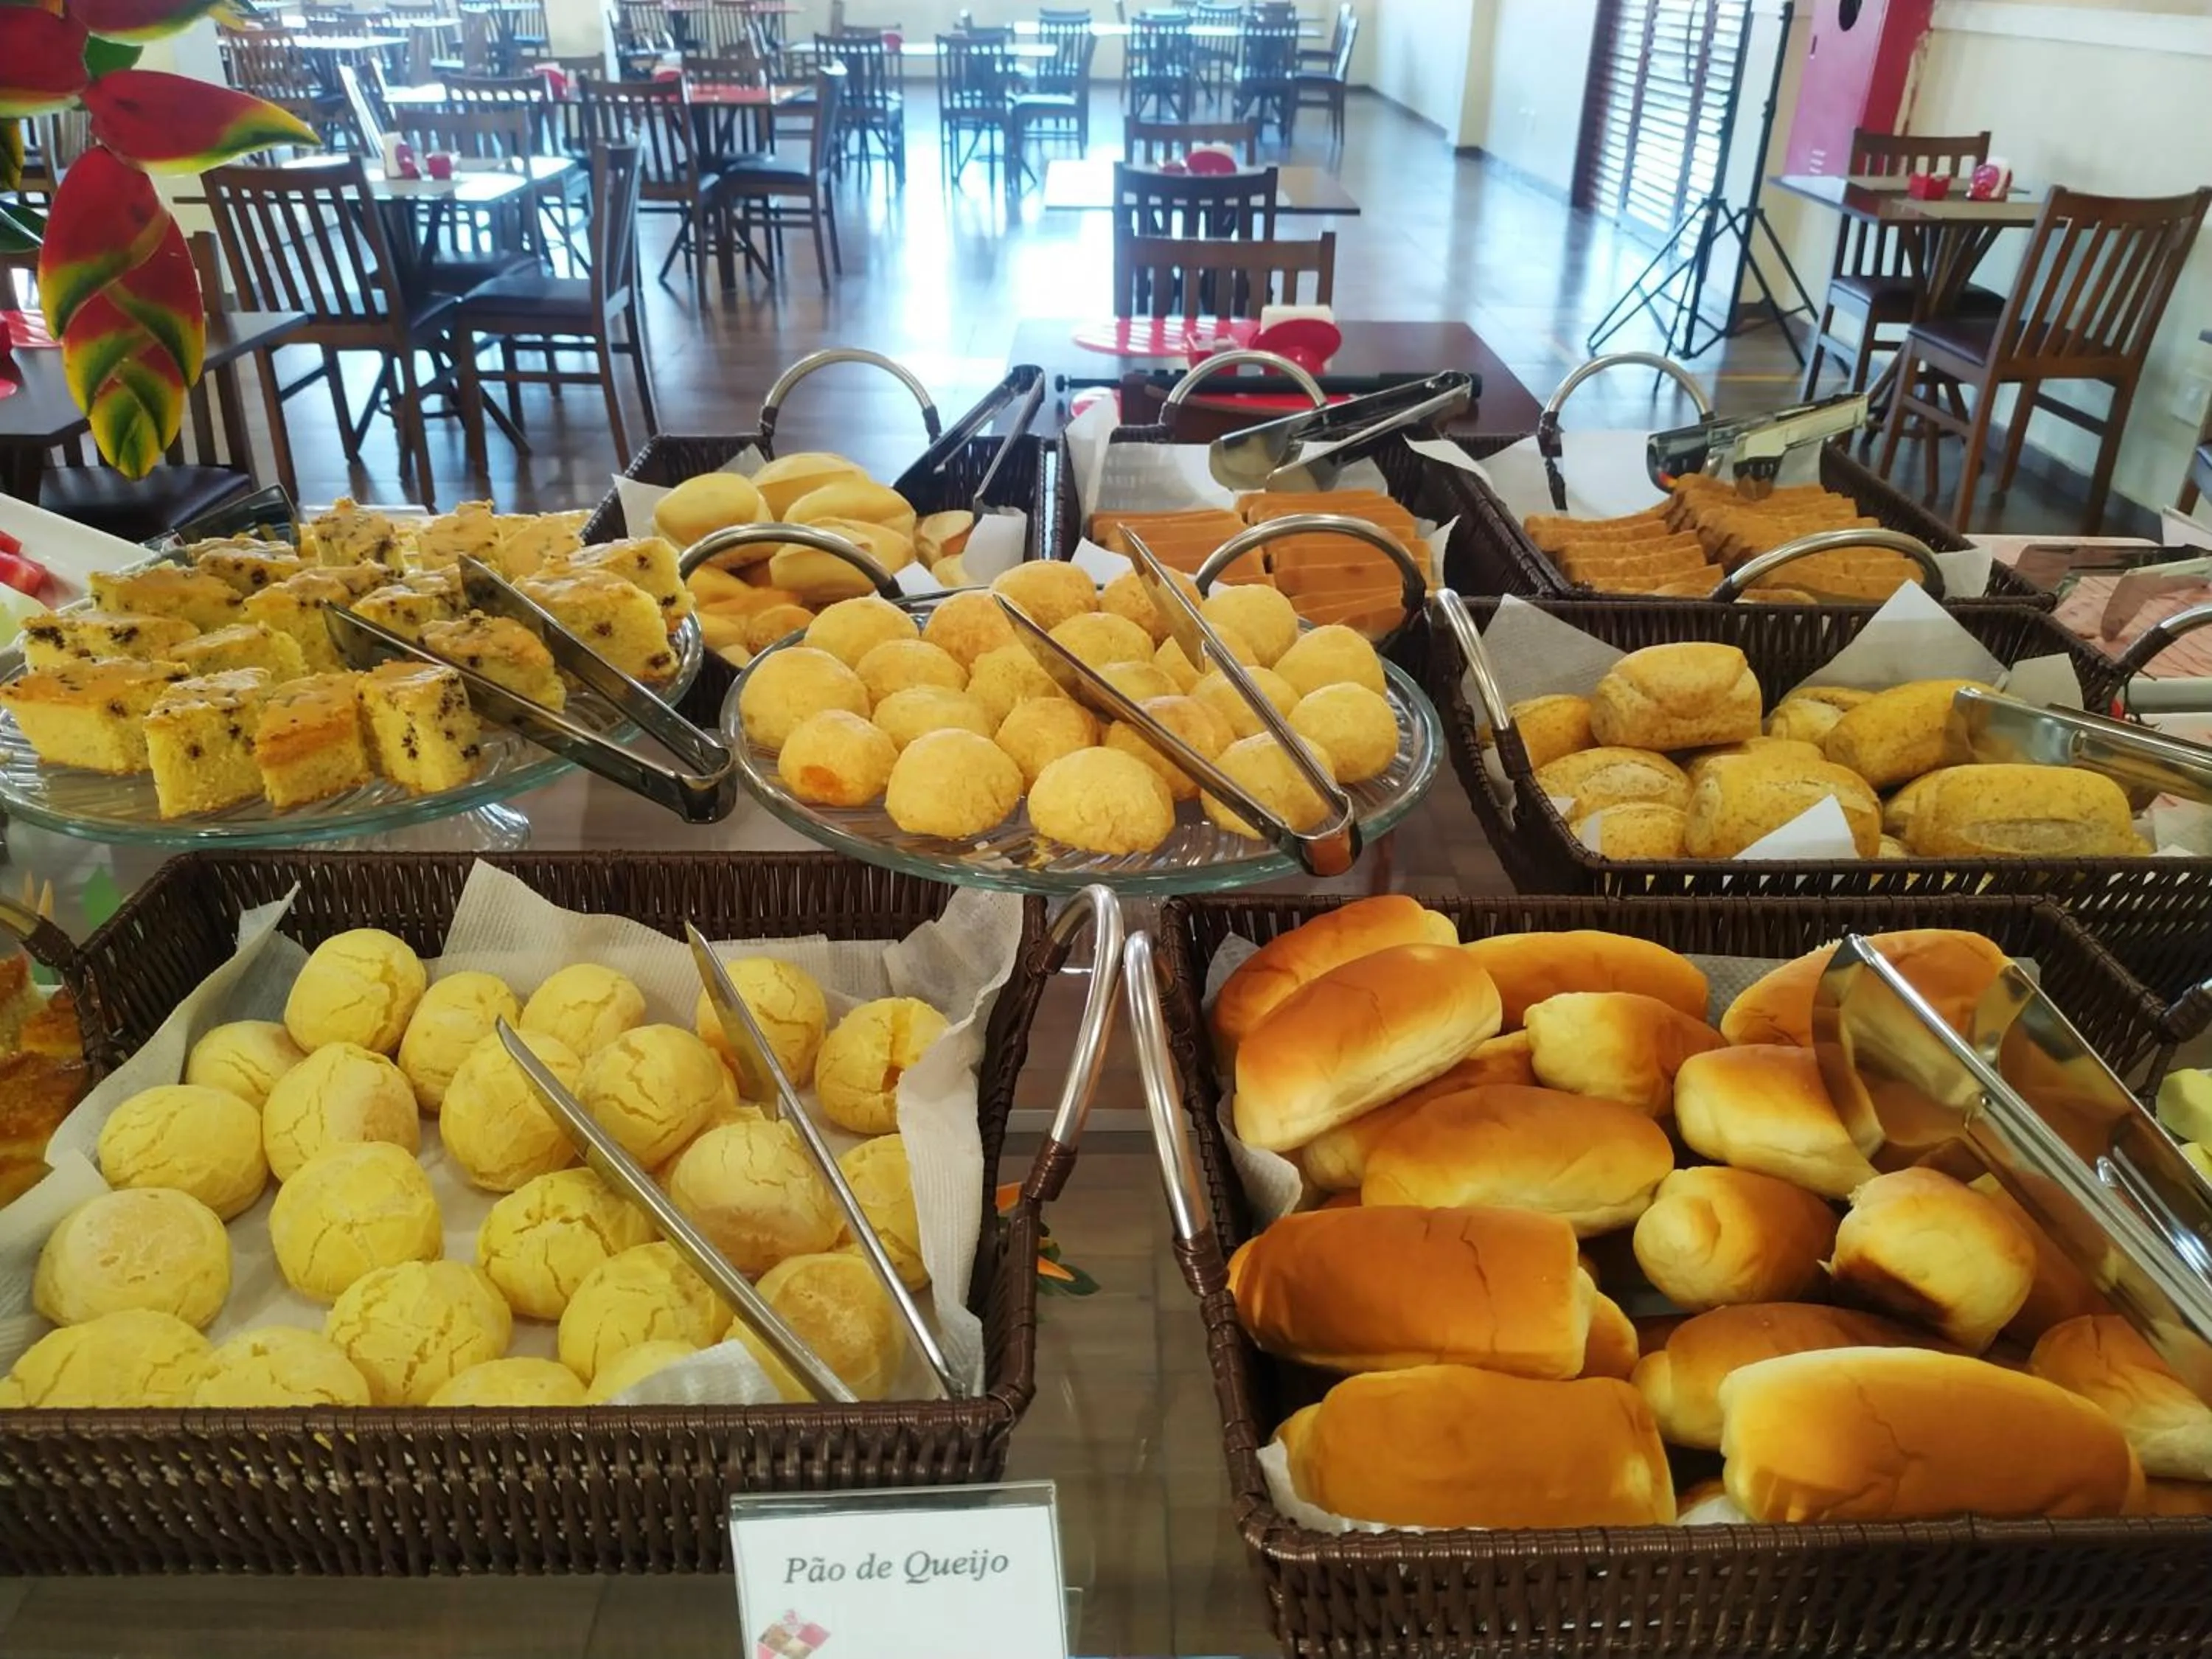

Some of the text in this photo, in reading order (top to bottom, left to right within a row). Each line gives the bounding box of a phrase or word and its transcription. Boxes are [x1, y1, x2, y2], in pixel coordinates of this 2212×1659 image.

[784, 1549, 1009, 1584] Pão de Queijo
